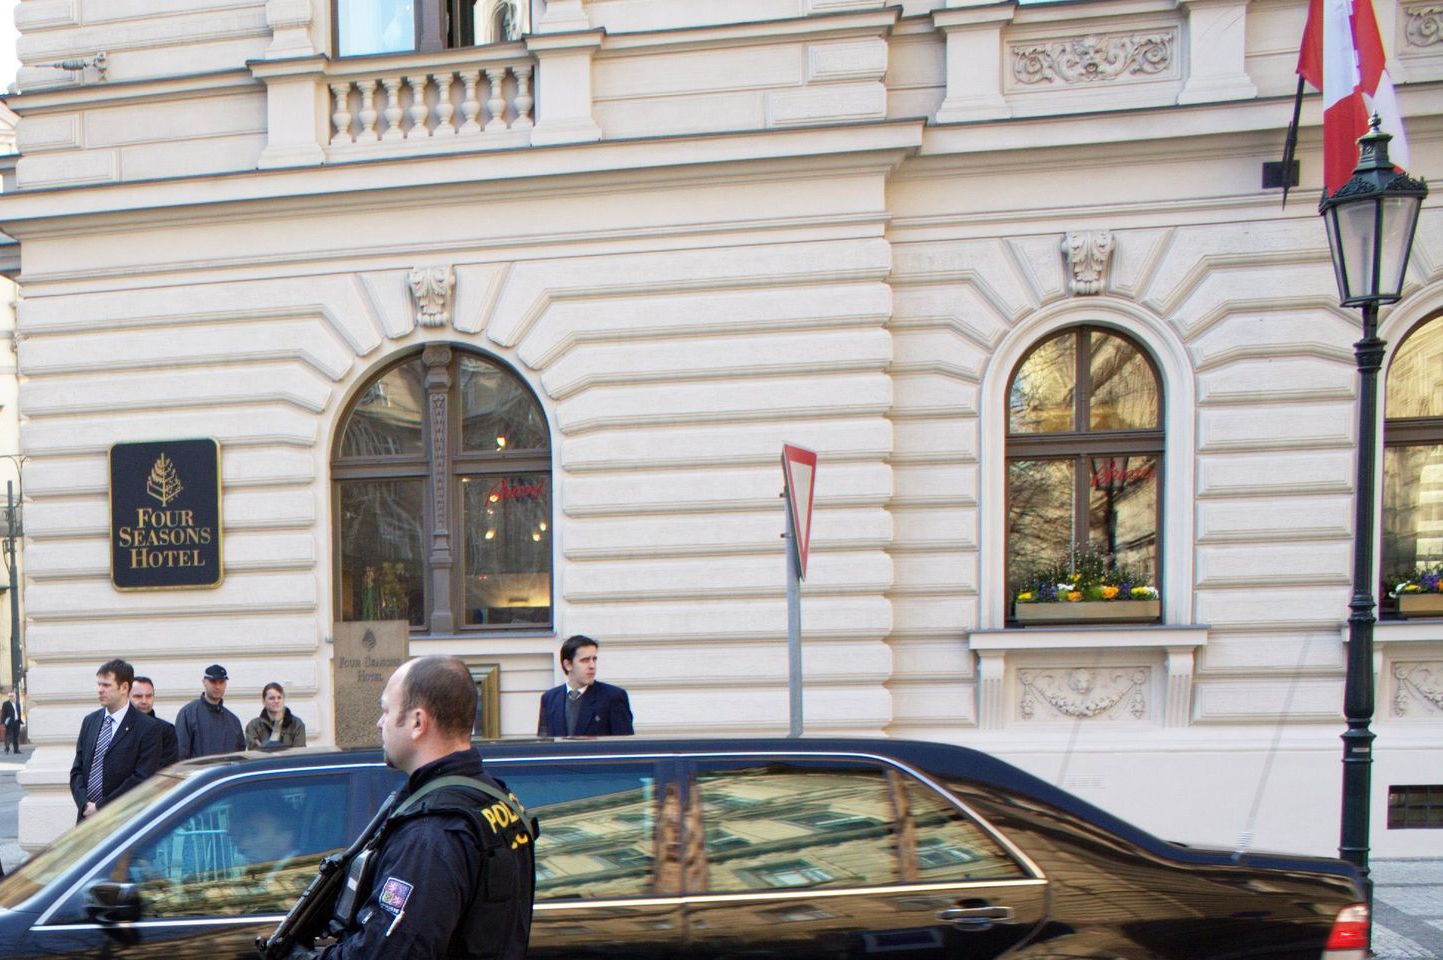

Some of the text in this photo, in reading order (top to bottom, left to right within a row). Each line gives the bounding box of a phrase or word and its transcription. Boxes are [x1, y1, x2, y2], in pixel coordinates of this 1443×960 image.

[136, 508, 194, 528] FOUR
[119, 527, 211, 547] SEASONS
[129, 548, 206, 569] HOTEL
